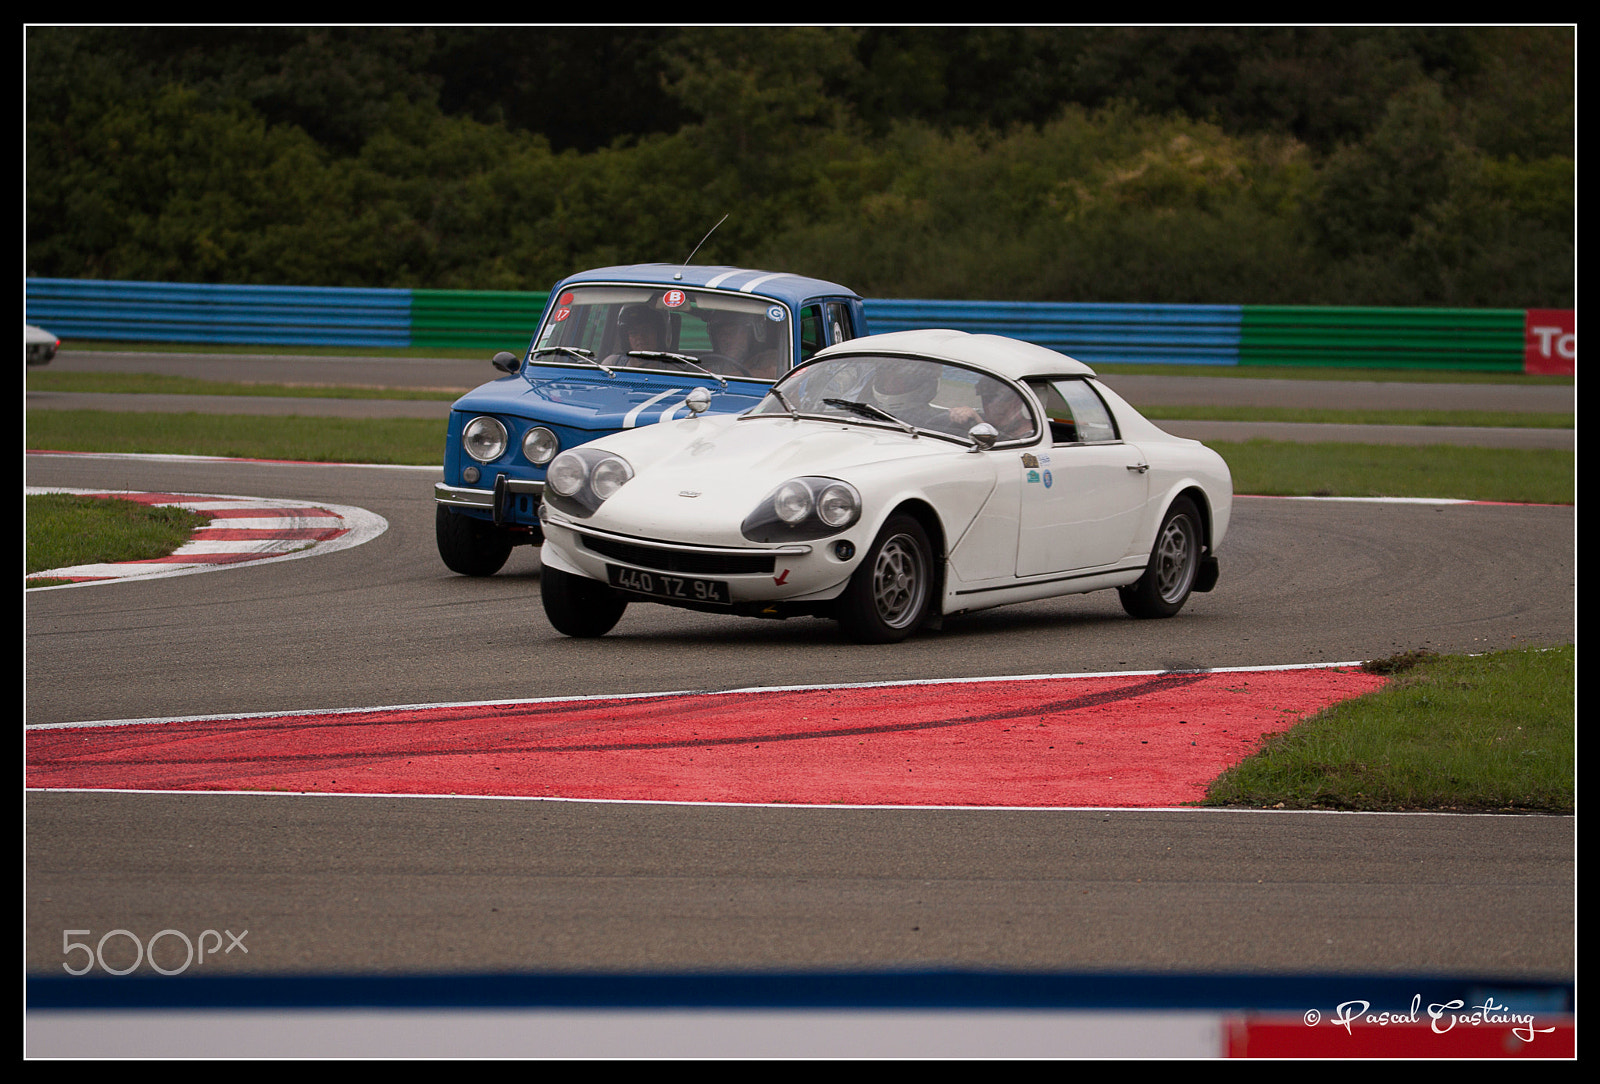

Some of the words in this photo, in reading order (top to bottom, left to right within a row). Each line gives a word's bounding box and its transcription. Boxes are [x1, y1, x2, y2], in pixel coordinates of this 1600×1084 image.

[670, 291, 681, 301] B
[557, 309, 570, 319] 17
[1532, 326, 1575, 359] To
[619, 568, 653, 592] 440
[660, 576, 687, 597] TZ
[693, 580, 720, 601] 94
